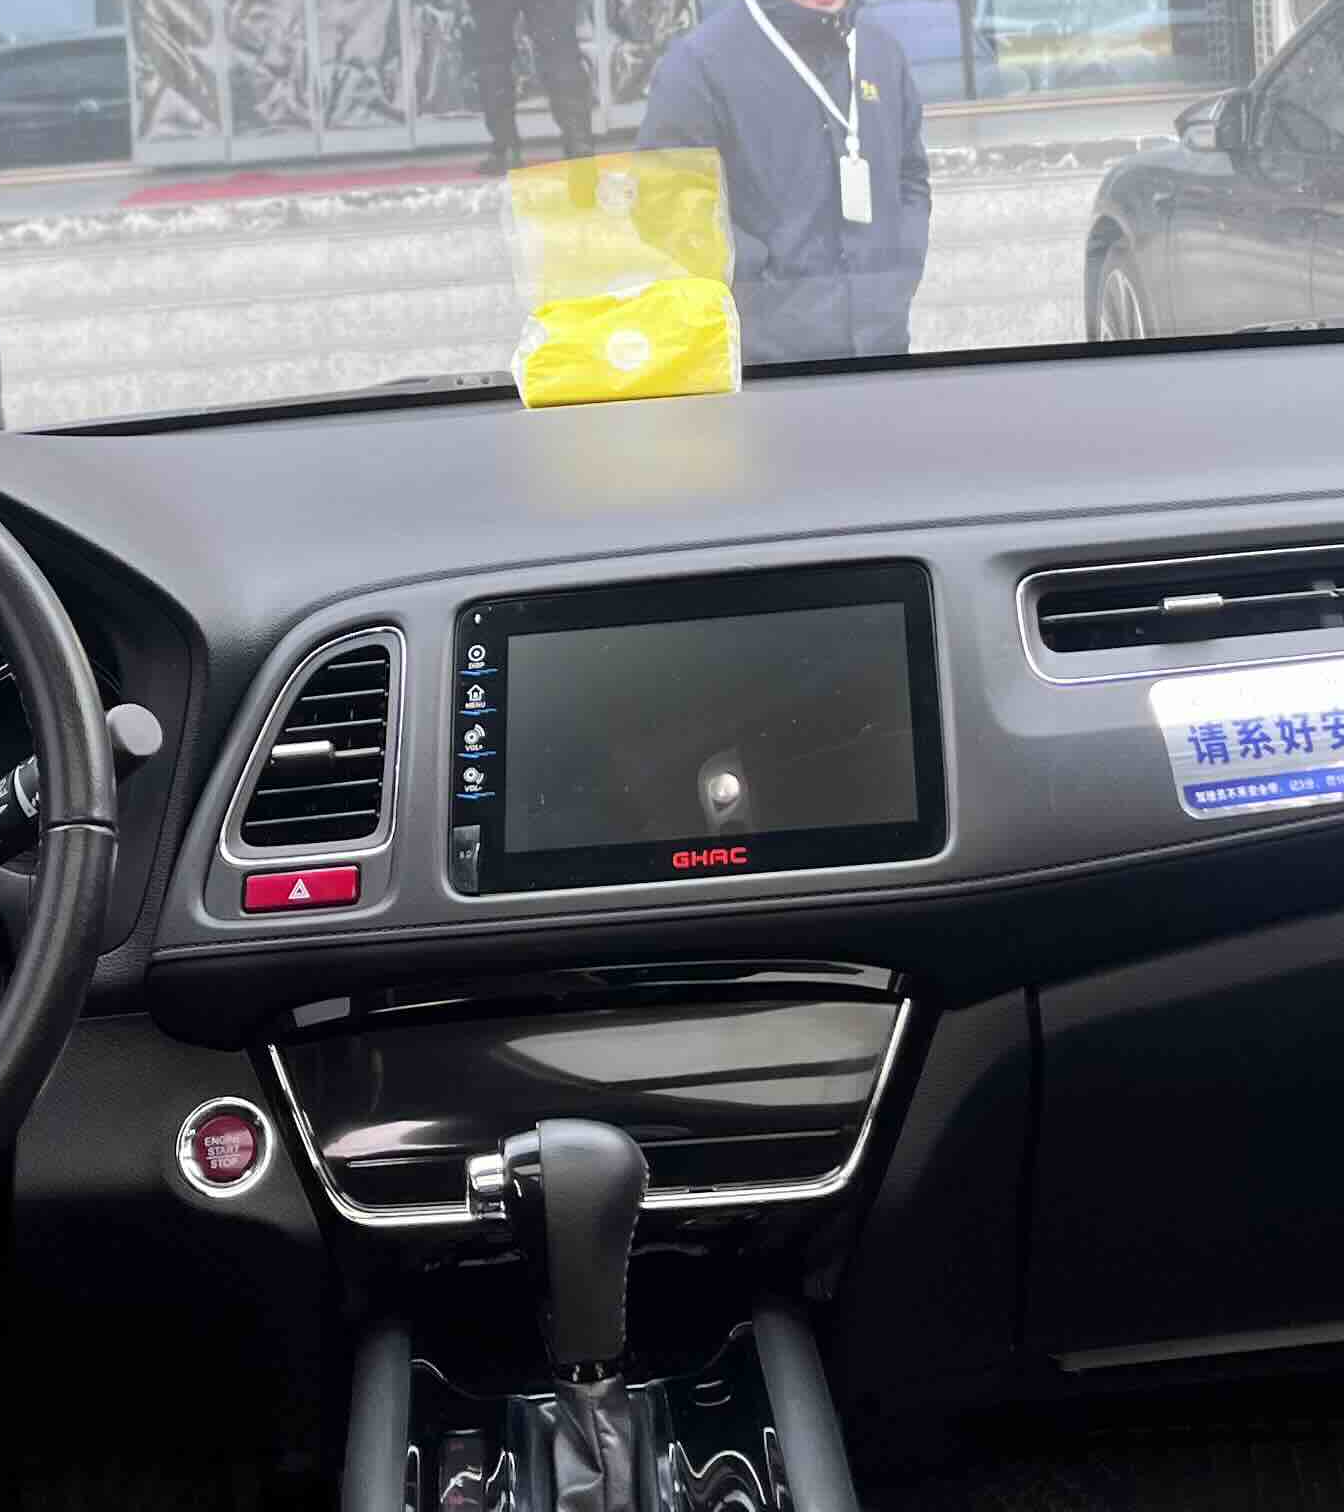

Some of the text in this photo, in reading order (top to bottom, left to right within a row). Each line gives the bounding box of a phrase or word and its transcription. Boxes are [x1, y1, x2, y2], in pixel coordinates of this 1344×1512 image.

[672, 846, 748, 869] GHAC
[207, 1144, 240, 1156] START
[210, 1158, 240, 1169] STOP
